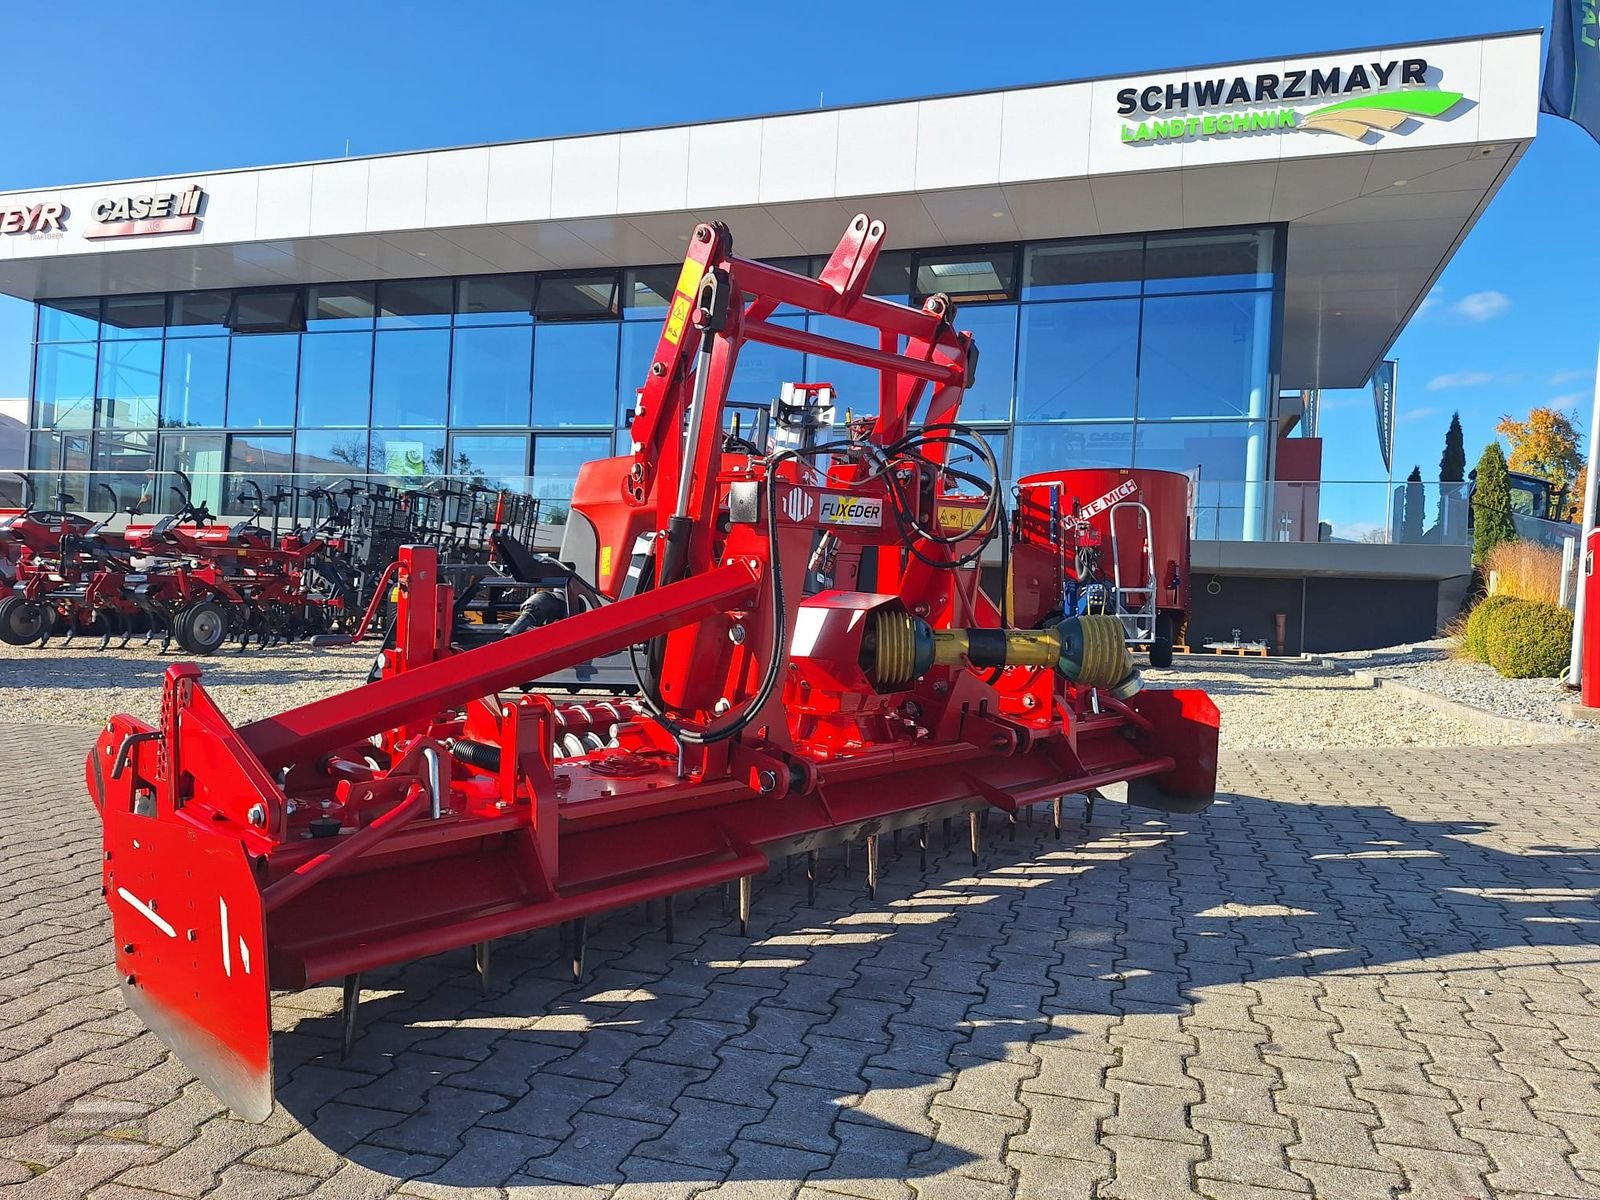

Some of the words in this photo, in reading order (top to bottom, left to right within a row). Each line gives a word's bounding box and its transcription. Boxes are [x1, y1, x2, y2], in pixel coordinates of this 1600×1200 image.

[1117, 58, 1429, 115] SCHWARZMAYR
[1121, 108, 1297, 143] LANDTECHNIK
[0, 201, 66, 234] EYR
[90, 193, 172, 223] CASE
[781, 487, 814, 522] TULIP
[821, 501, 881, 519] FLIXEDER
[1063, 501, 1102, 529] MTE
[1103, 480, 1137, 506] MICH
